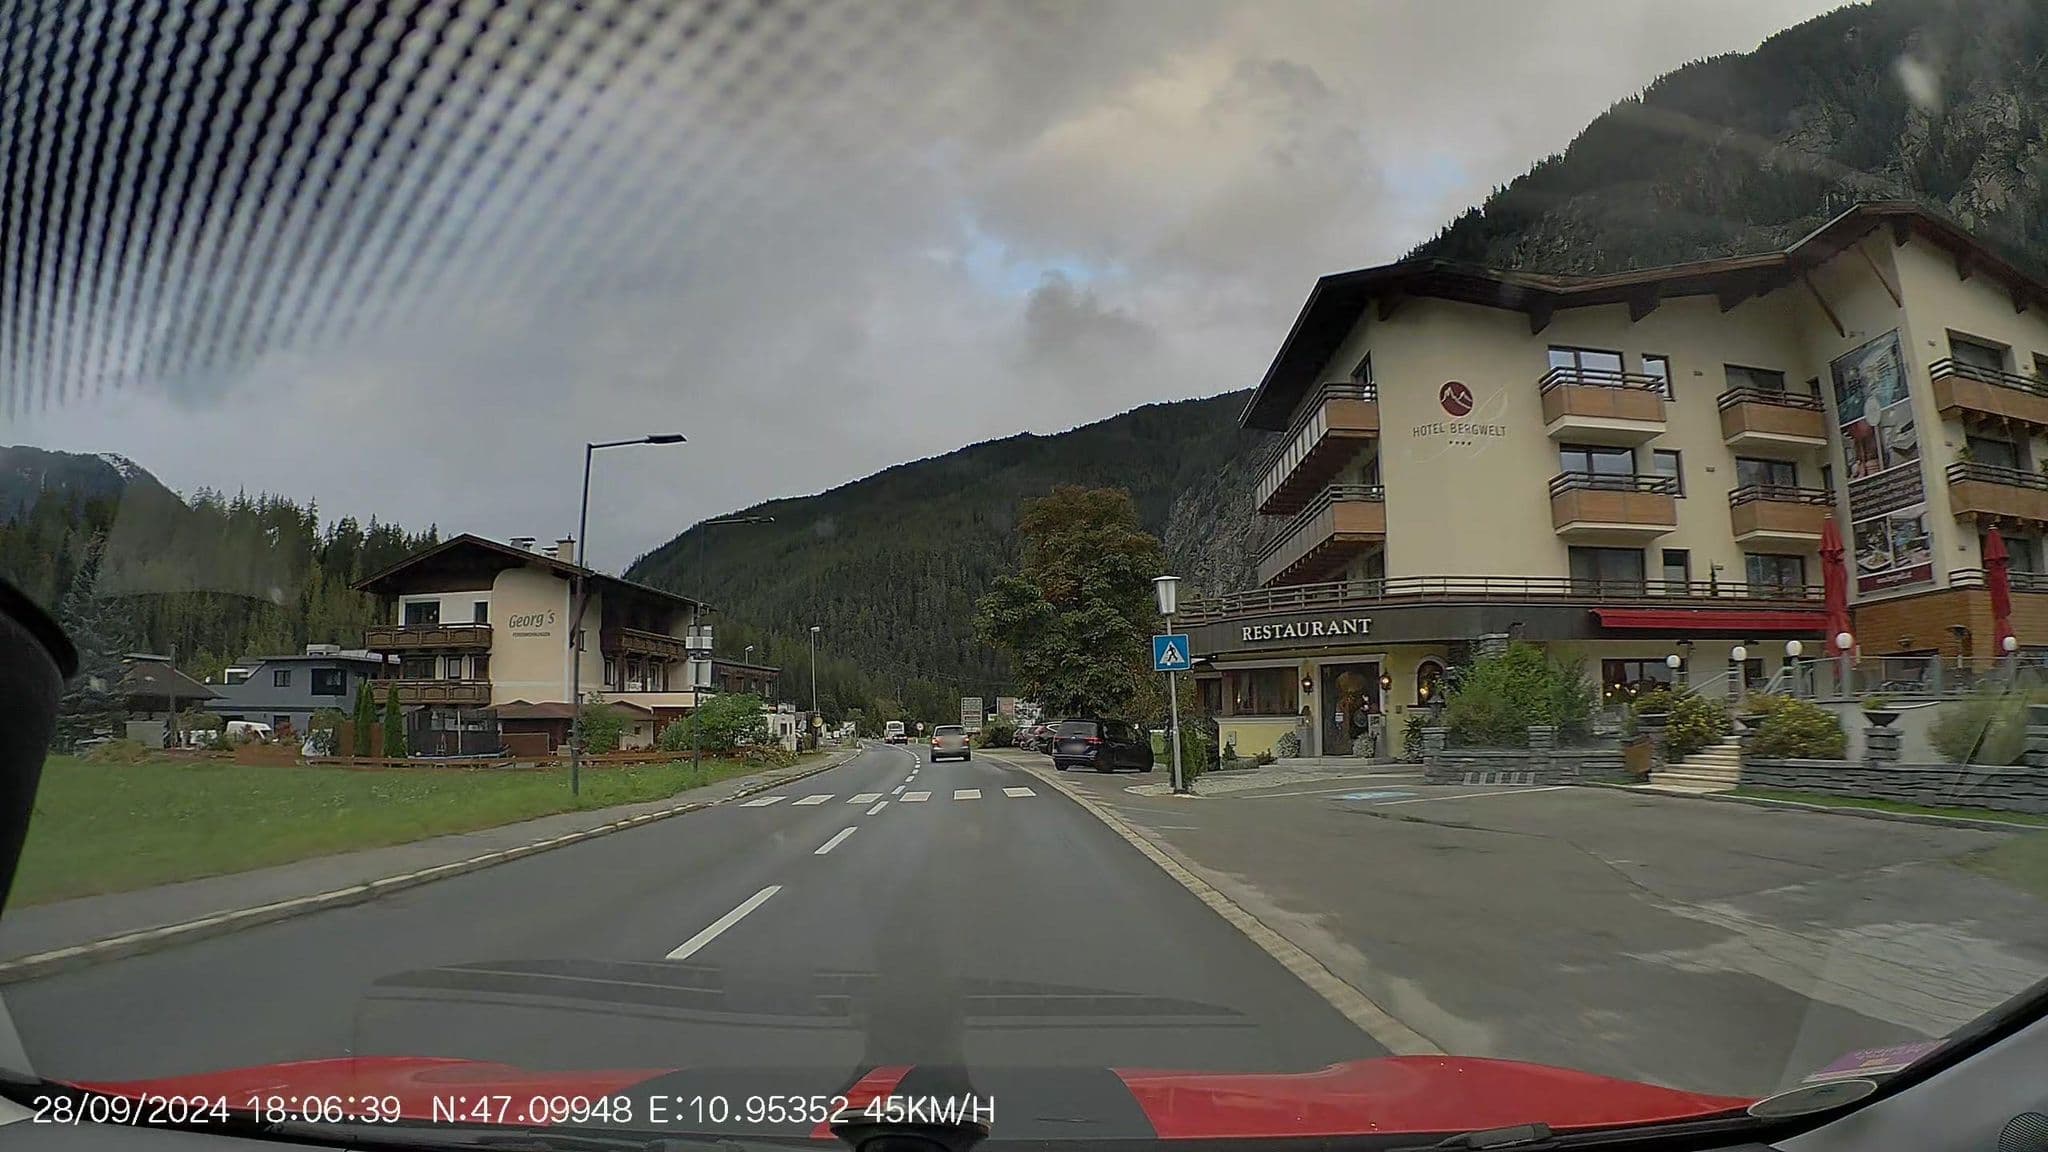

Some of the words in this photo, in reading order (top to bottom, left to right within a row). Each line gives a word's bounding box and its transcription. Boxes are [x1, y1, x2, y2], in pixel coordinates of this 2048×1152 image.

[1412, 422, 1445, 437] HOTEL
[1450, 422, 1507, 437] BERGWELT
[1241, 618, 1372, 641] RESTAURANT
